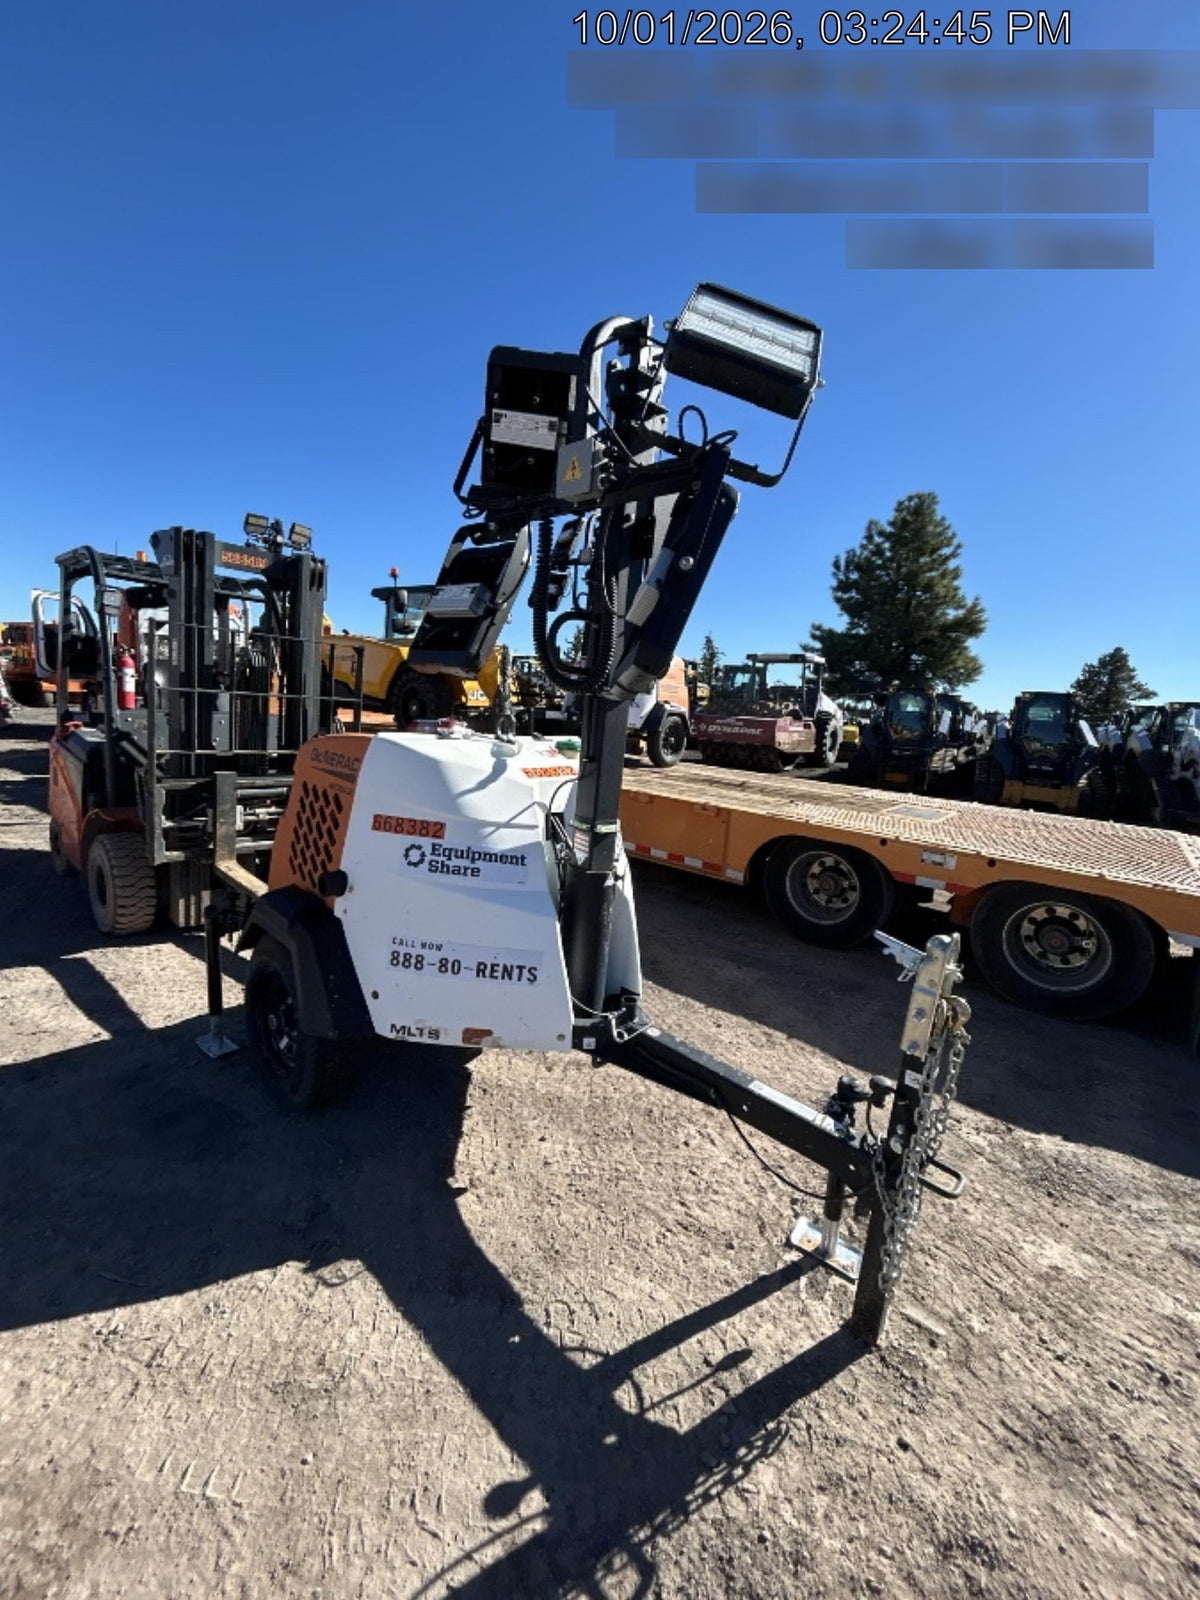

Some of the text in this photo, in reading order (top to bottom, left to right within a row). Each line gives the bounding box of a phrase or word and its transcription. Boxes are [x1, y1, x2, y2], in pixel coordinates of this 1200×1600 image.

[372, 814, 445, 839] 668382
[430, 842, 527, 867] Equipment
[428, 859, 481, 877] Share
[392, 936, 416, 949] CALL
[390, 950, 538, 984] 888-80-RENTS
